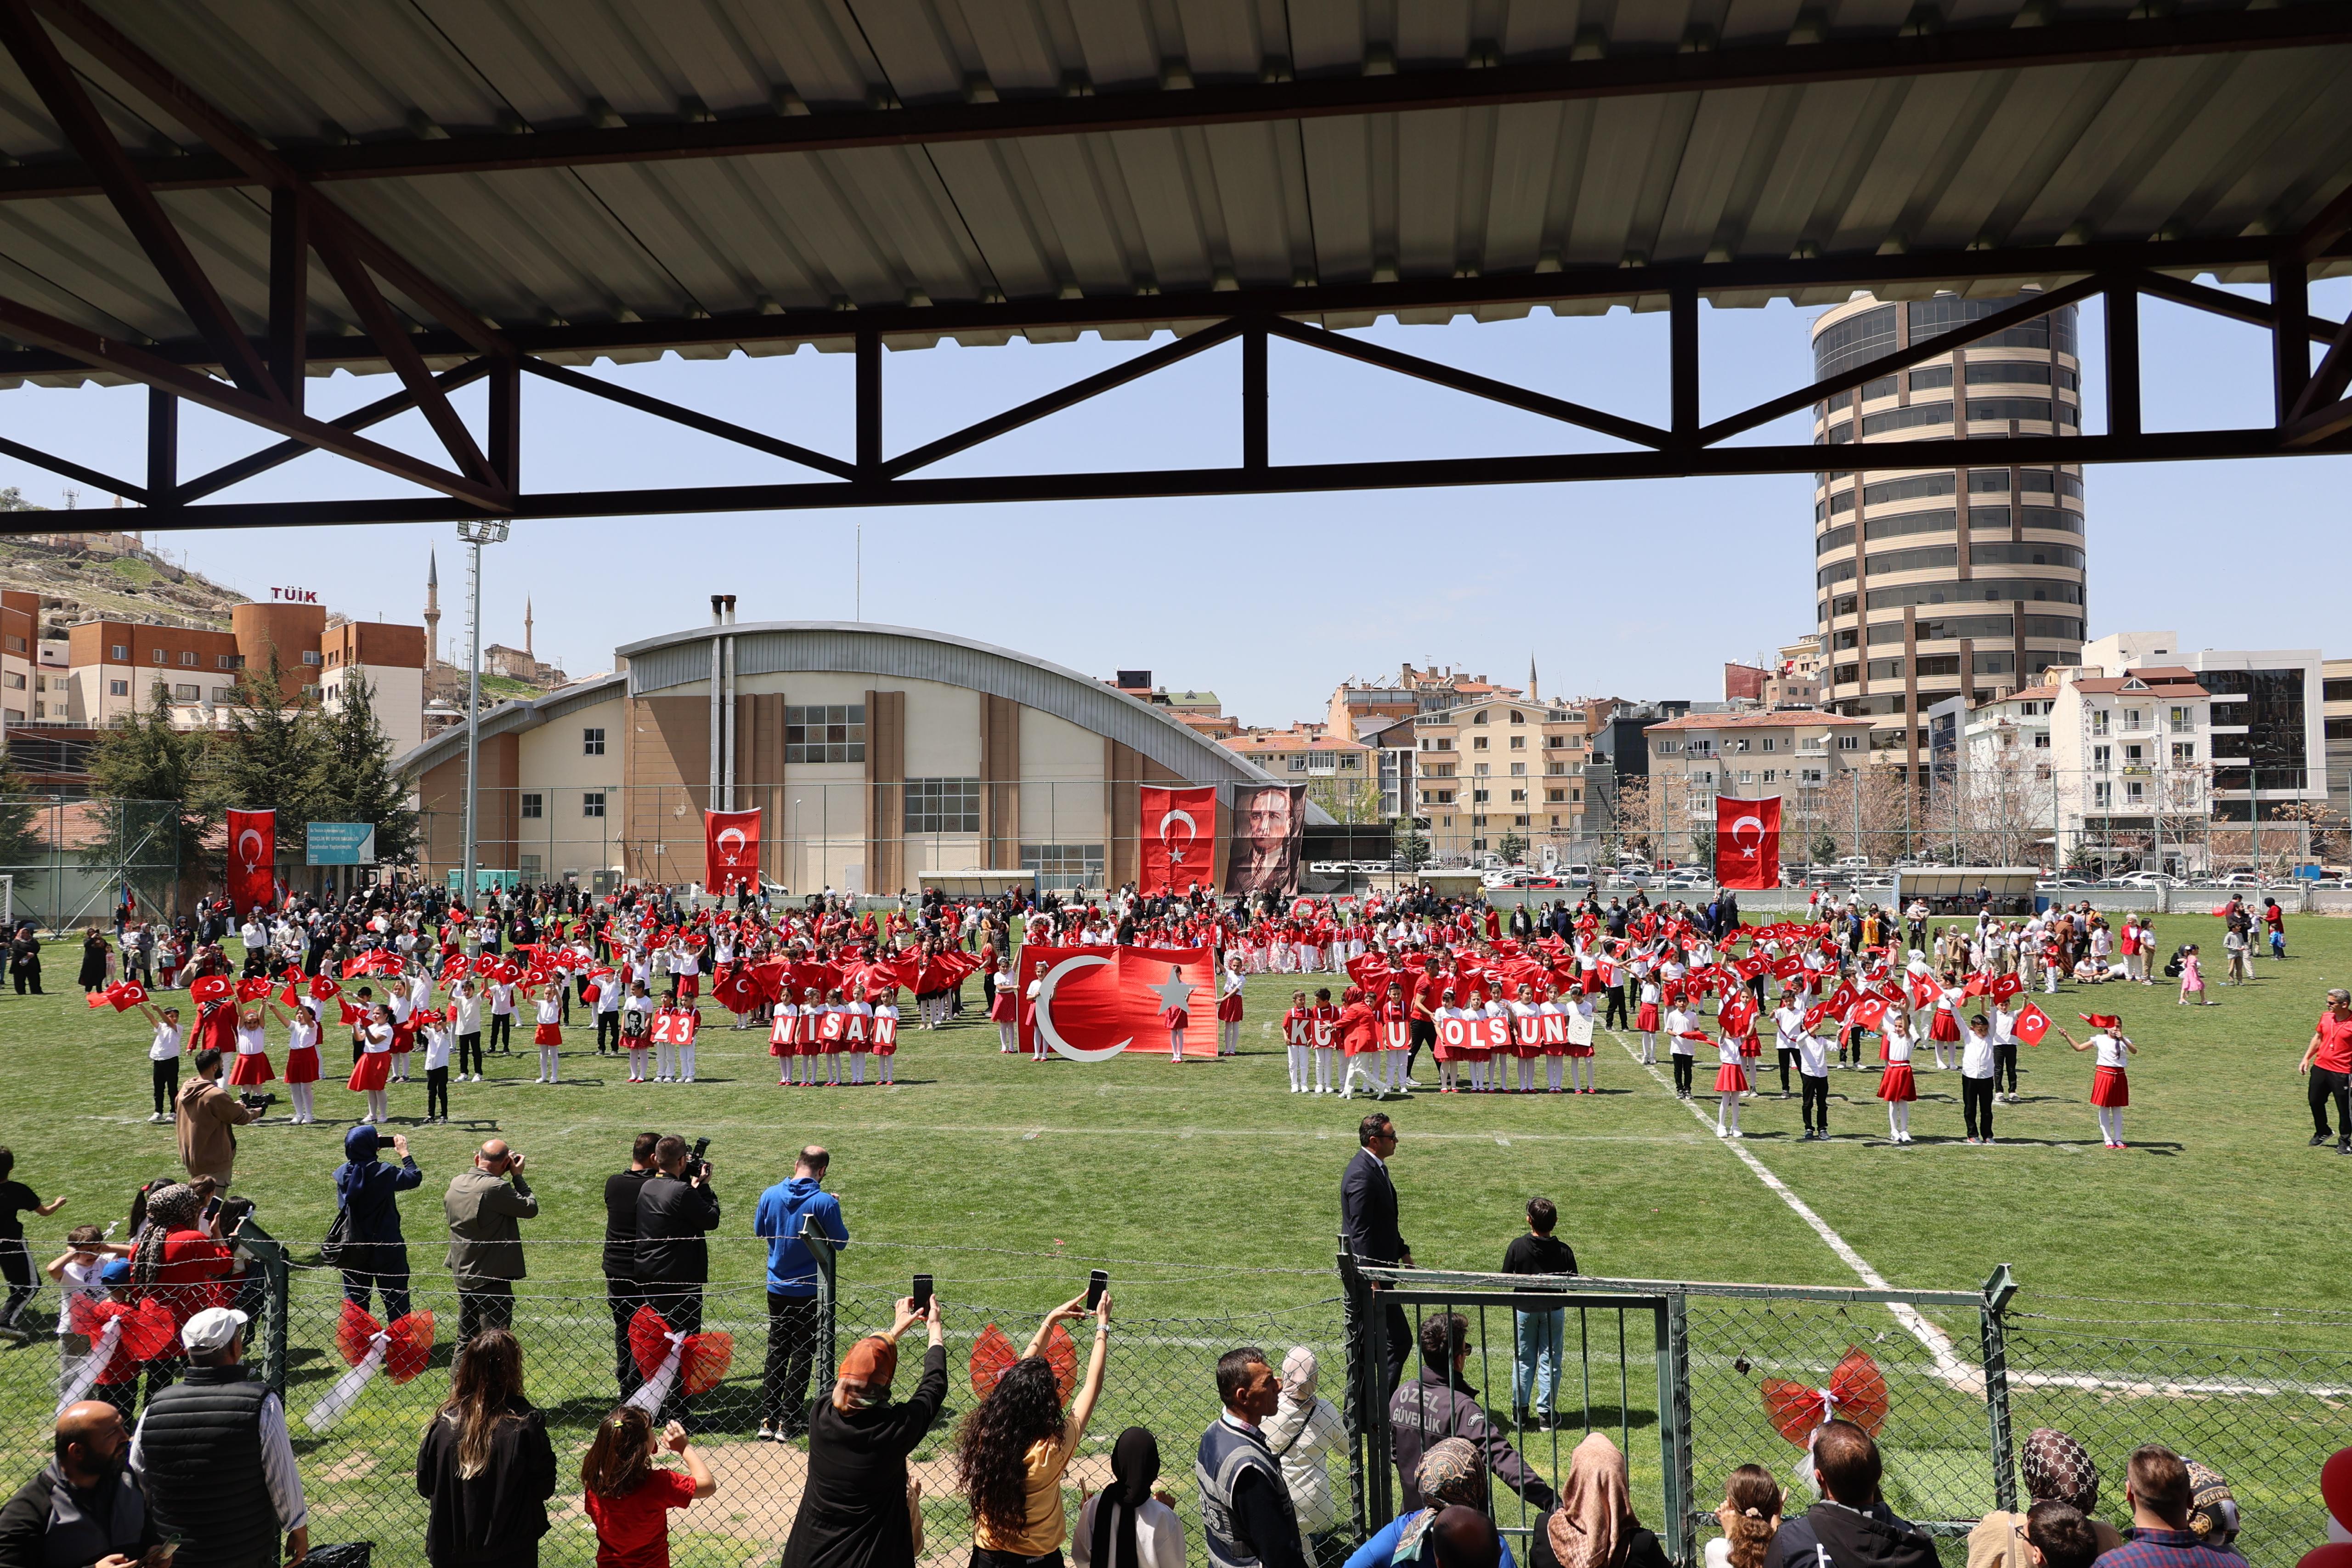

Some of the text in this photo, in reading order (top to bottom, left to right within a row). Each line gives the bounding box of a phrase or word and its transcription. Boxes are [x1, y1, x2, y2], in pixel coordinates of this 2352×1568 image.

[271, 586, 317, 603] TÜİK
[654, 1013, 893, 1044] 23 NİSAN
[1291, 1019, 1406, 1047] KUU
[1445, 1015, 1564, 1047] OLSUN
[1400, 1386, 1439, 1414] ÖZEL
